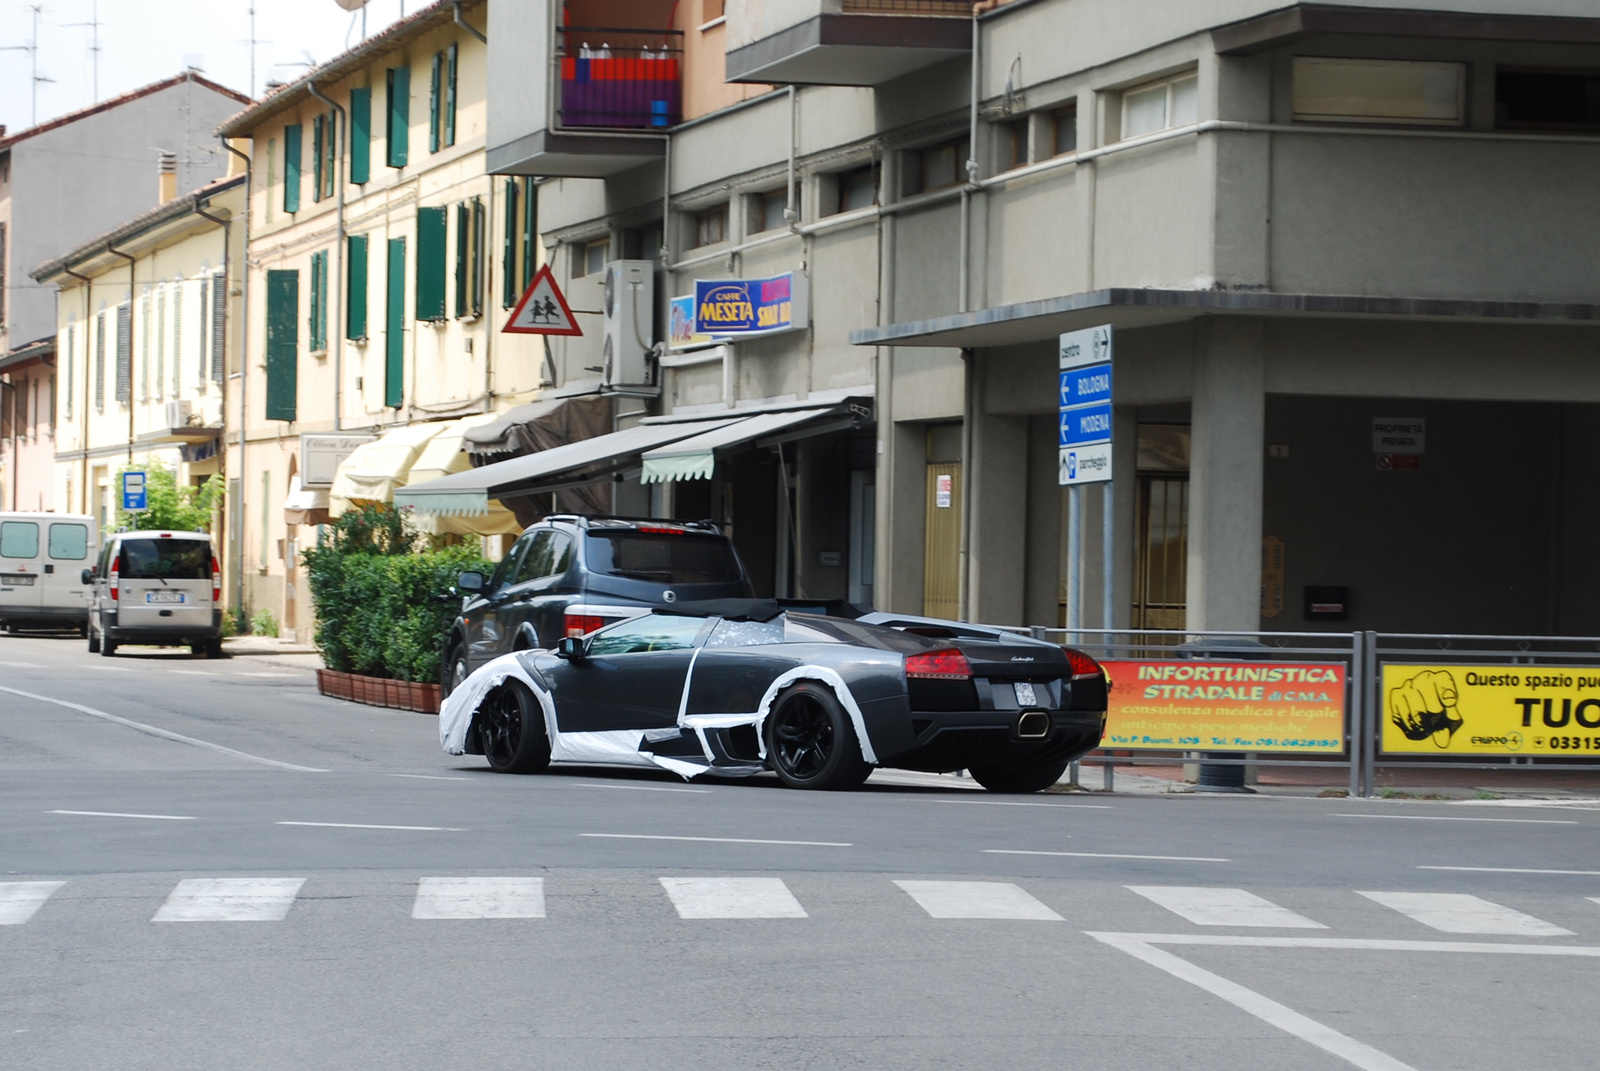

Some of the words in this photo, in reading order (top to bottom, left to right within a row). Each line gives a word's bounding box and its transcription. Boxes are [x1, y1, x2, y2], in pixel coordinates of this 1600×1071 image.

[699, 302, 754, 322] MESETA
[1078, 373, 1110, 396] BOLOGNA
[1080, 413, 1110, 434] MODENA
[1381, 436, 1417, 446] PRIVATA
[1138, 665, 1338, 683] INFORTUNISTICA
[1465, 672, 1520, 686] Questo
[1525, 674, 1573, 691] spazio
[1143, 685, 1265, 701] STRADALE
[1121, 703, 1213, 716] consulenza
[1215, 704, 1274, 717] medica
[1277, 708, 1287, 717] e
[1290, 705, 1339, 720] legale
[1514, 697, 1600, 729] TUO
[1121, 720, 1187, 732] anticipo
[1190, 722, 1236, 733] spese
[1240, 721, 1307, 733] mediche
[1111, 735, 1128, 743] Via
[1549, 736, 1600, 749] 03315
